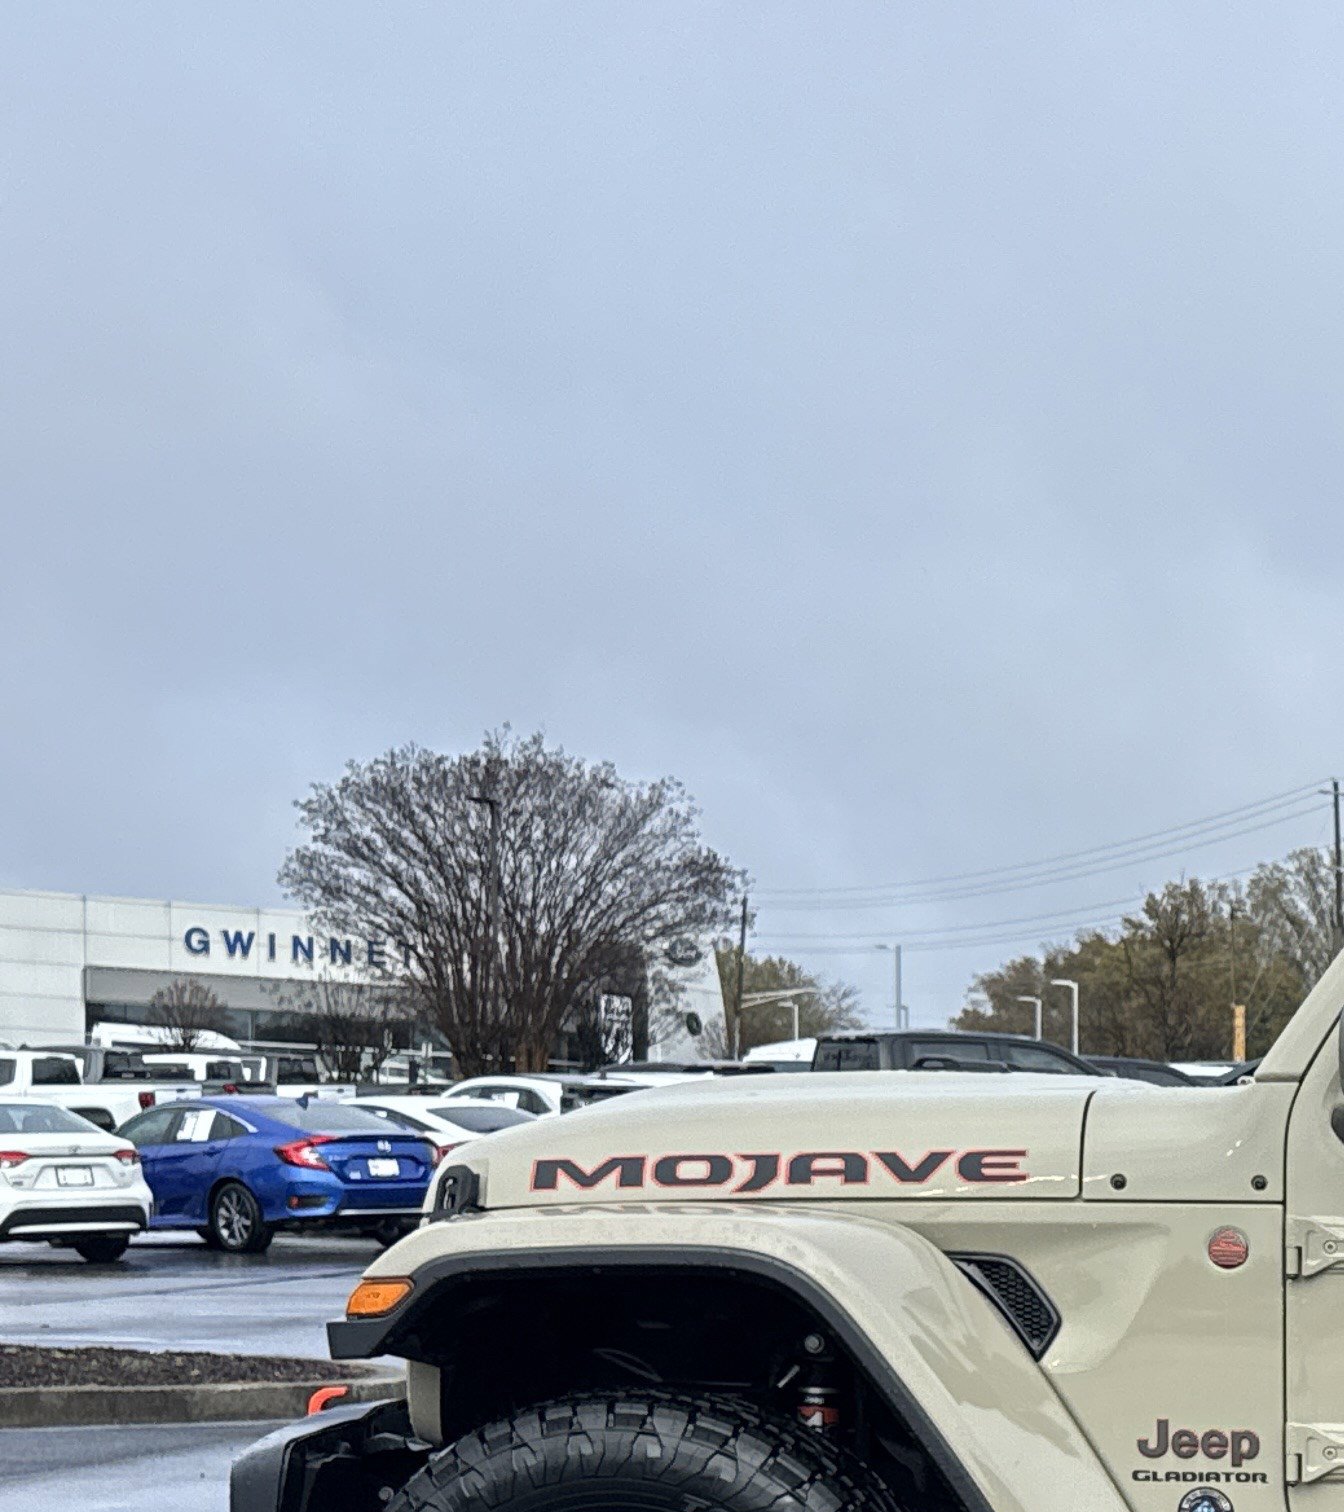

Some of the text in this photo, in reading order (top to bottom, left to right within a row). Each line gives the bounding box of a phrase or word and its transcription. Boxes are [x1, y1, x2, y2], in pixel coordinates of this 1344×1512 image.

[530, 1149, 1030, 1193] MOJAVE
[1136, 1418, 1260, 1468] Jeep
[1131, 1469, 1269, 1484] GLADIATOR
